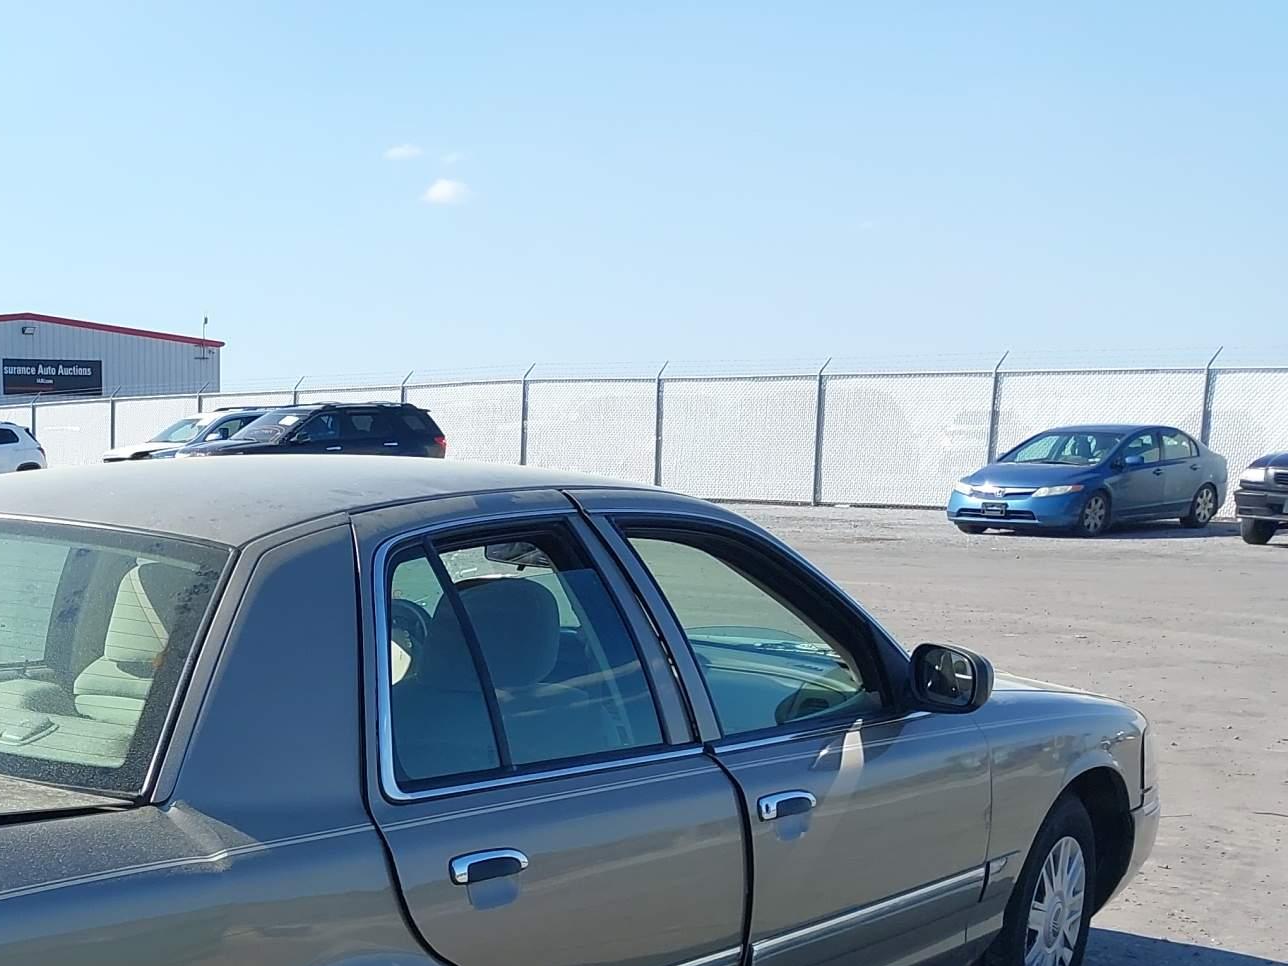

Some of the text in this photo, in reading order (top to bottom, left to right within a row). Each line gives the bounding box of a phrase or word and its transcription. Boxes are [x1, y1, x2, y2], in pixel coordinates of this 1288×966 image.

[3, 364, 92, 376] surance Auto Auctions
